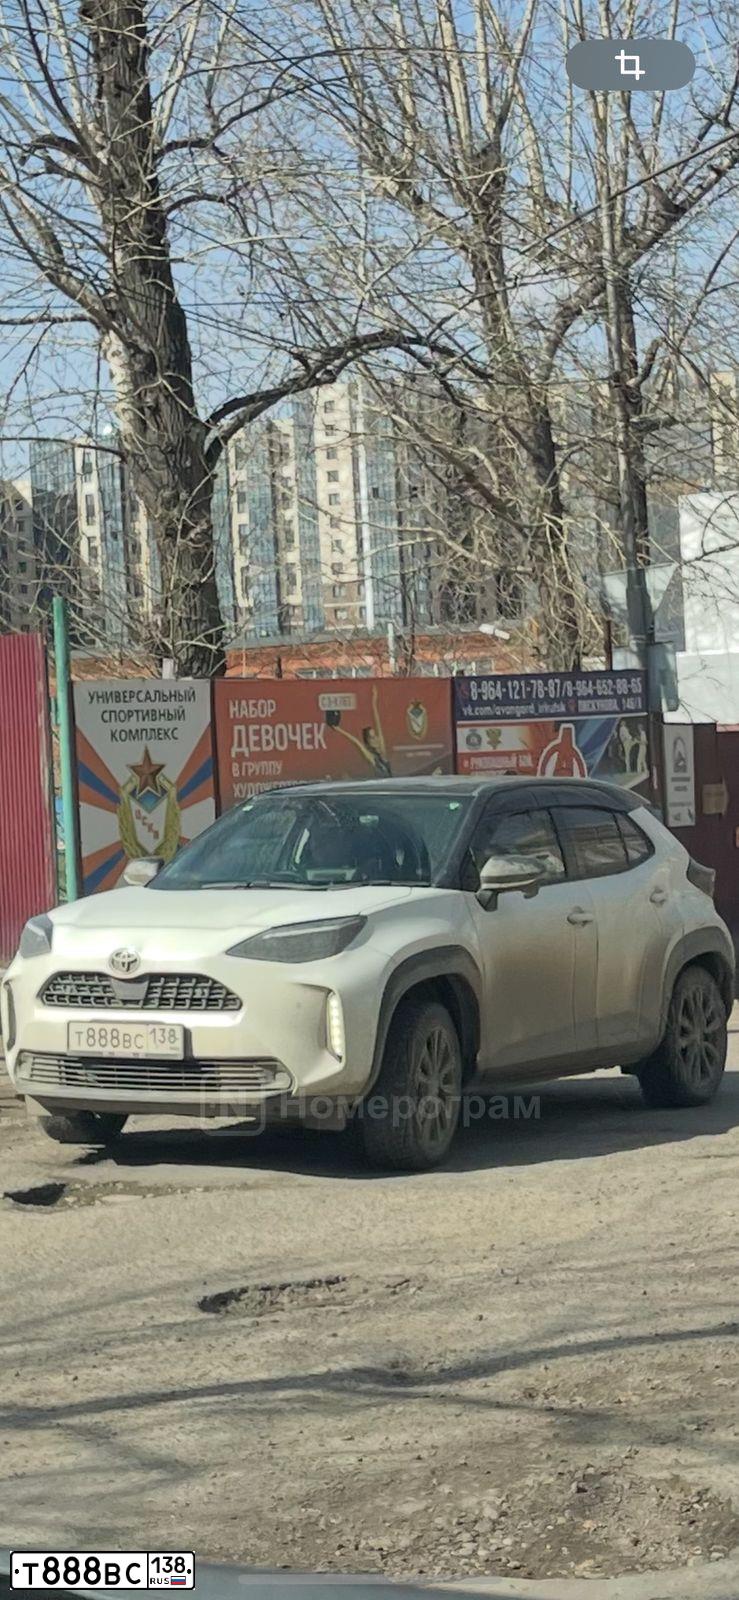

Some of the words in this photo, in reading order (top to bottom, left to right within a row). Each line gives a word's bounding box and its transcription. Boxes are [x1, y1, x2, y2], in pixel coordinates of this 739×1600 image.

[88, 687, 196, 704] УНИВЕРСАЛЬНЫЙ
[101, 706, 186, 723] СПОРТИВНЫЙ
[229, 699, 276, 718] НАБОР
[110, 727, 179, 742] КОМПЛЕКС
[231, 723, 327, 758] ДЕВОЧЕК
[232, 763, 240, 777] В
[242, 761, 282, 776] ГРУППУ
[75, 1027, 145, 1049] Т888ВС
[149, 1028, 177, 1044] 138
